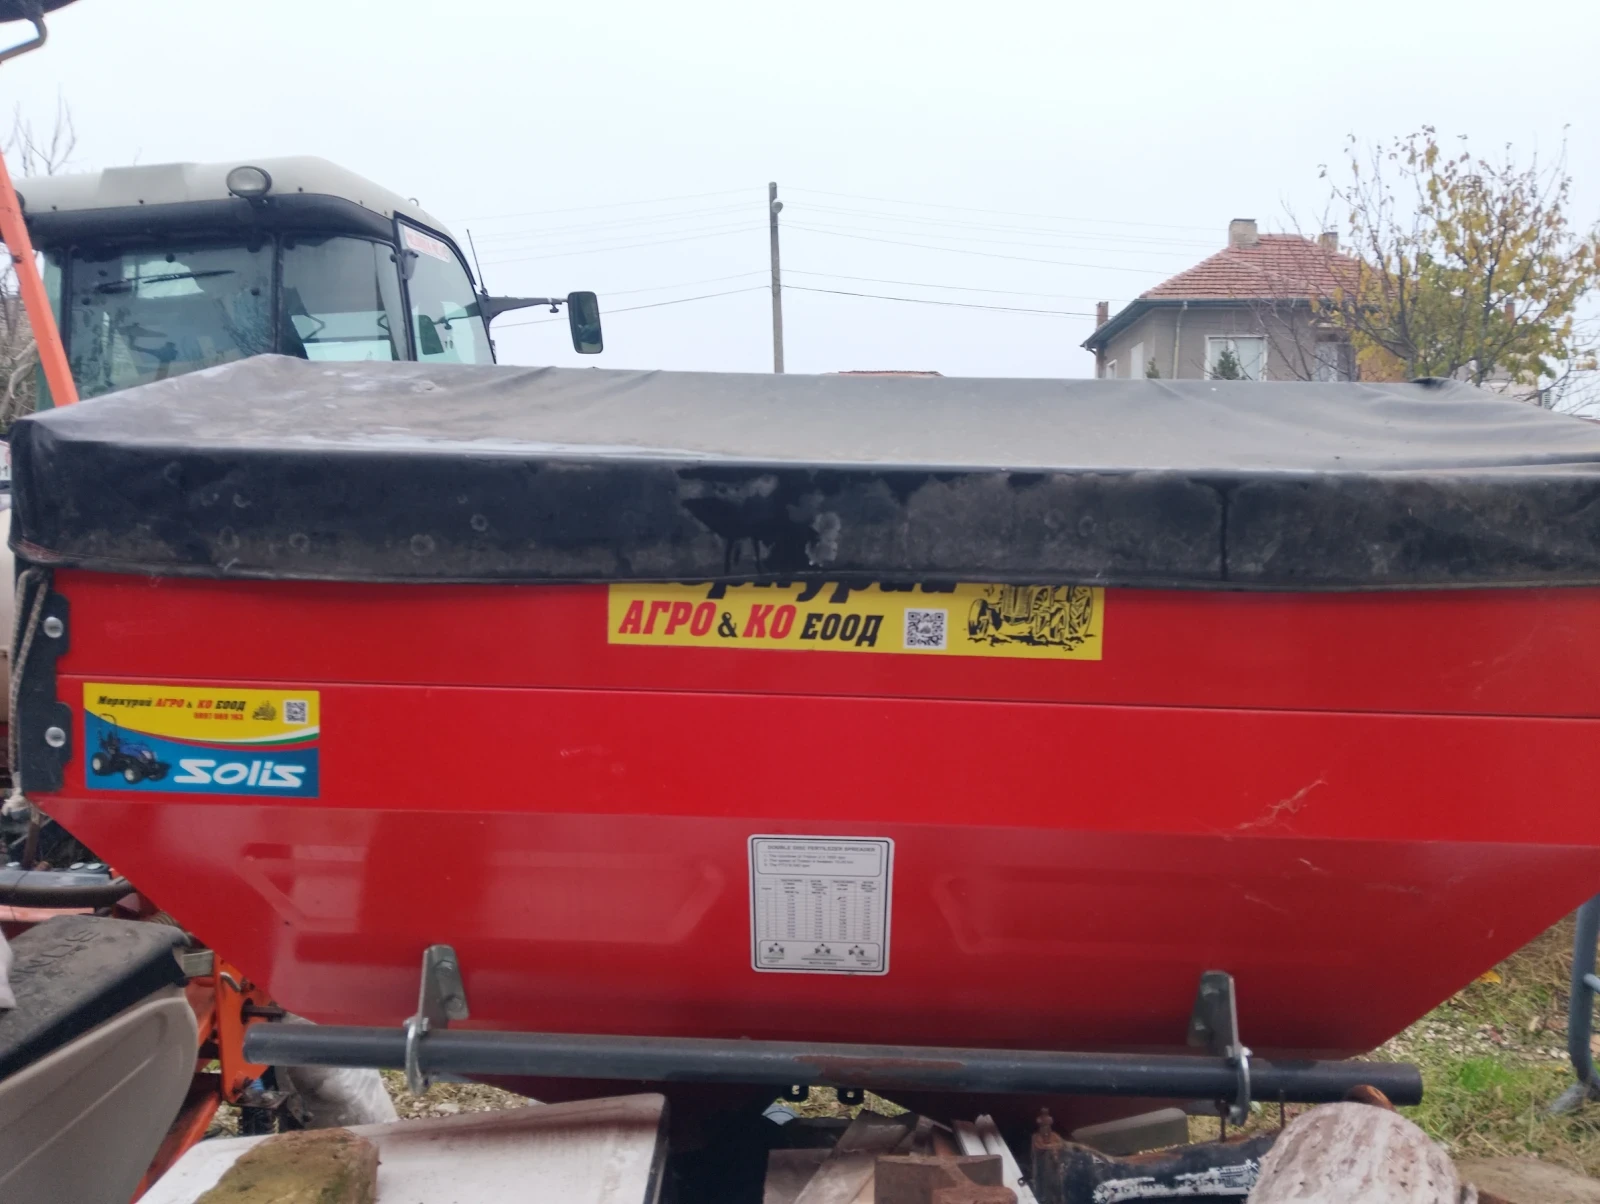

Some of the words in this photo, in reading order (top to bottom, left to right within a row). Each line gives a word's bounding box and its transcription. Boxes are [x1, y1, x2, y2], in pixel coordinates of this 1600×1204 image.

[618, 600, 717, 637] АГРО
[717, 612, 738, 639] &
[742, 604, 797, 640] КО
[799, 612, 884, 647] ЕООД
[155, 698, 185, 708] АГРО
